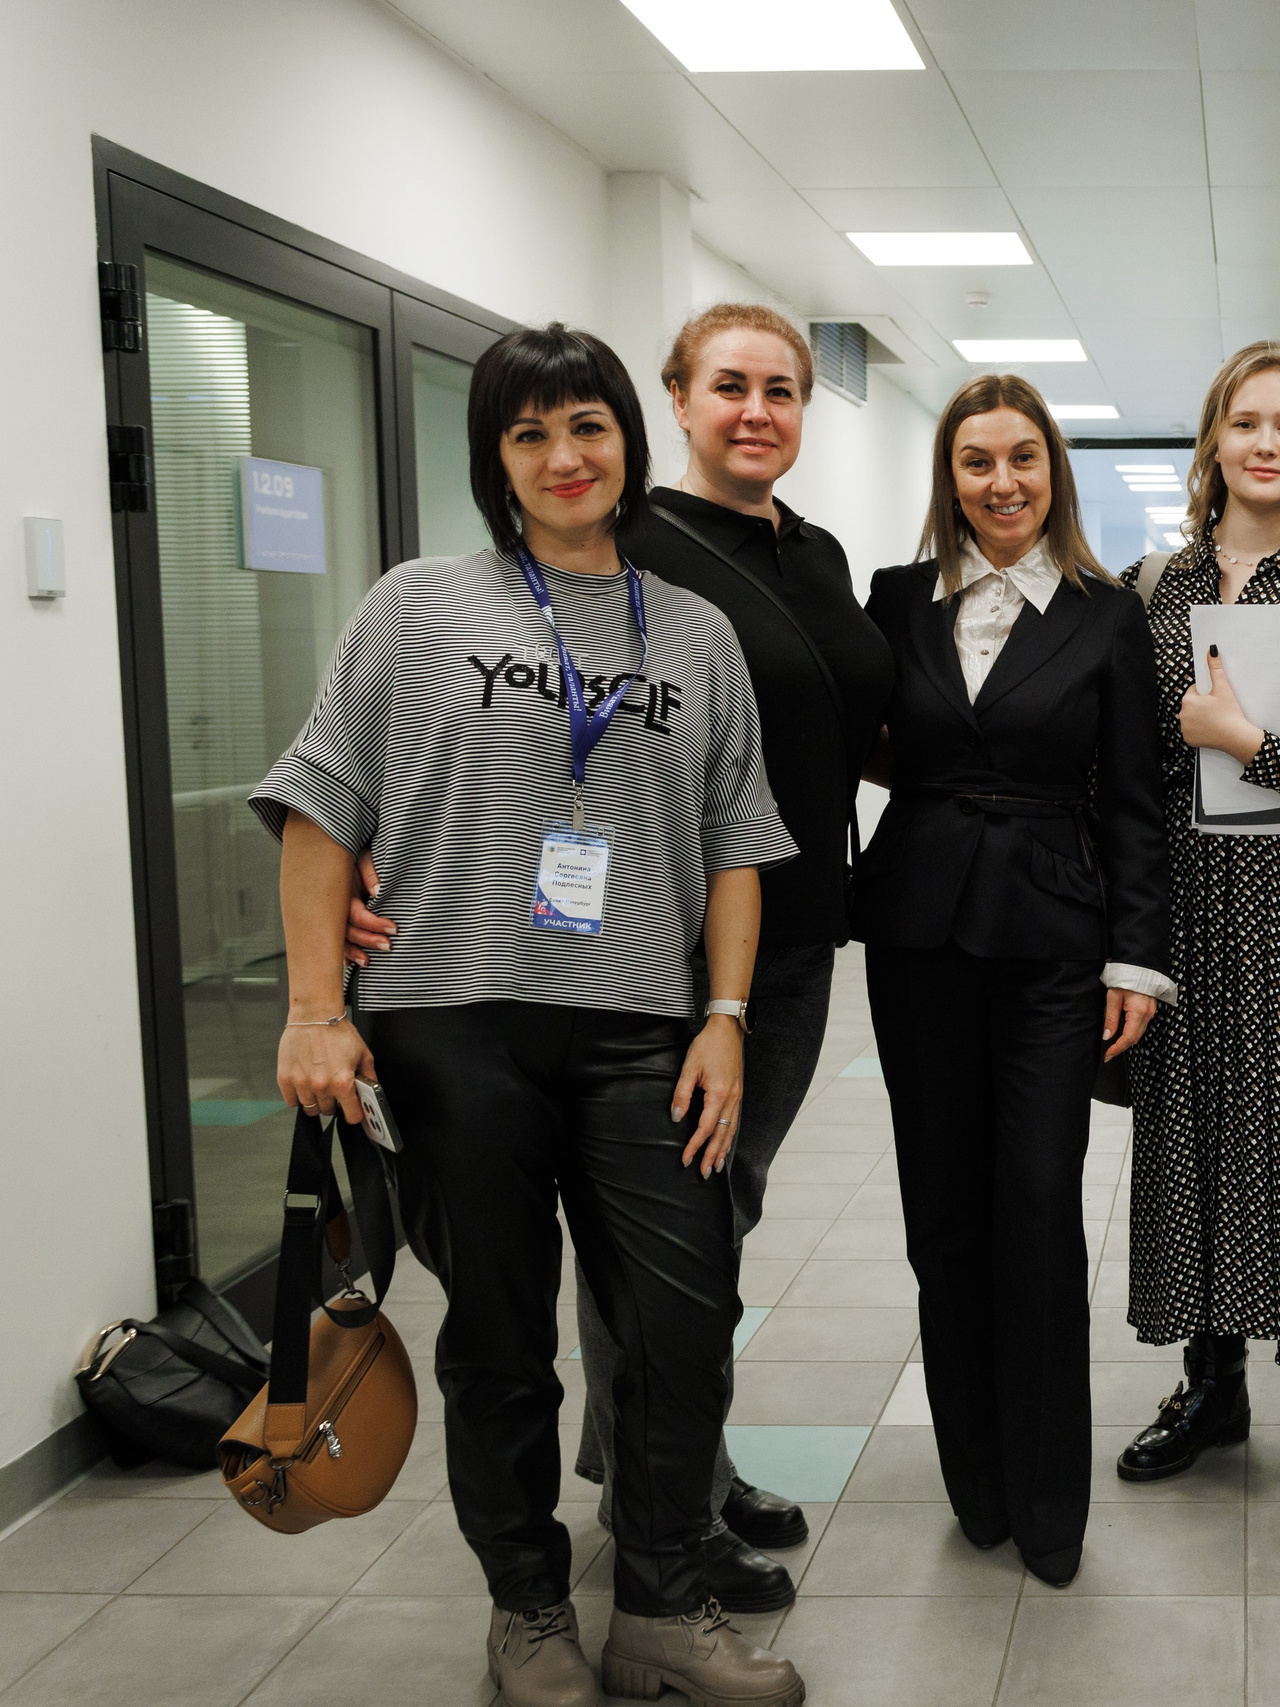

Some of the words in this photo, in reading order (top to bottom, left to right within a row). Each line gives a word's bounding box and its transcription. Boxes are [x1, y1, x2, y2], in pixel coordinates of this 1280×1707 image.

[567, 672, 583, 712] таланты!
[557, 863, 591, 872] Антонина
[554, 871, 592, 881] Сергеевна
[552, 880, 592, 889] Подлесных
[543, 918, 592, 930] УЧАСТНИК
